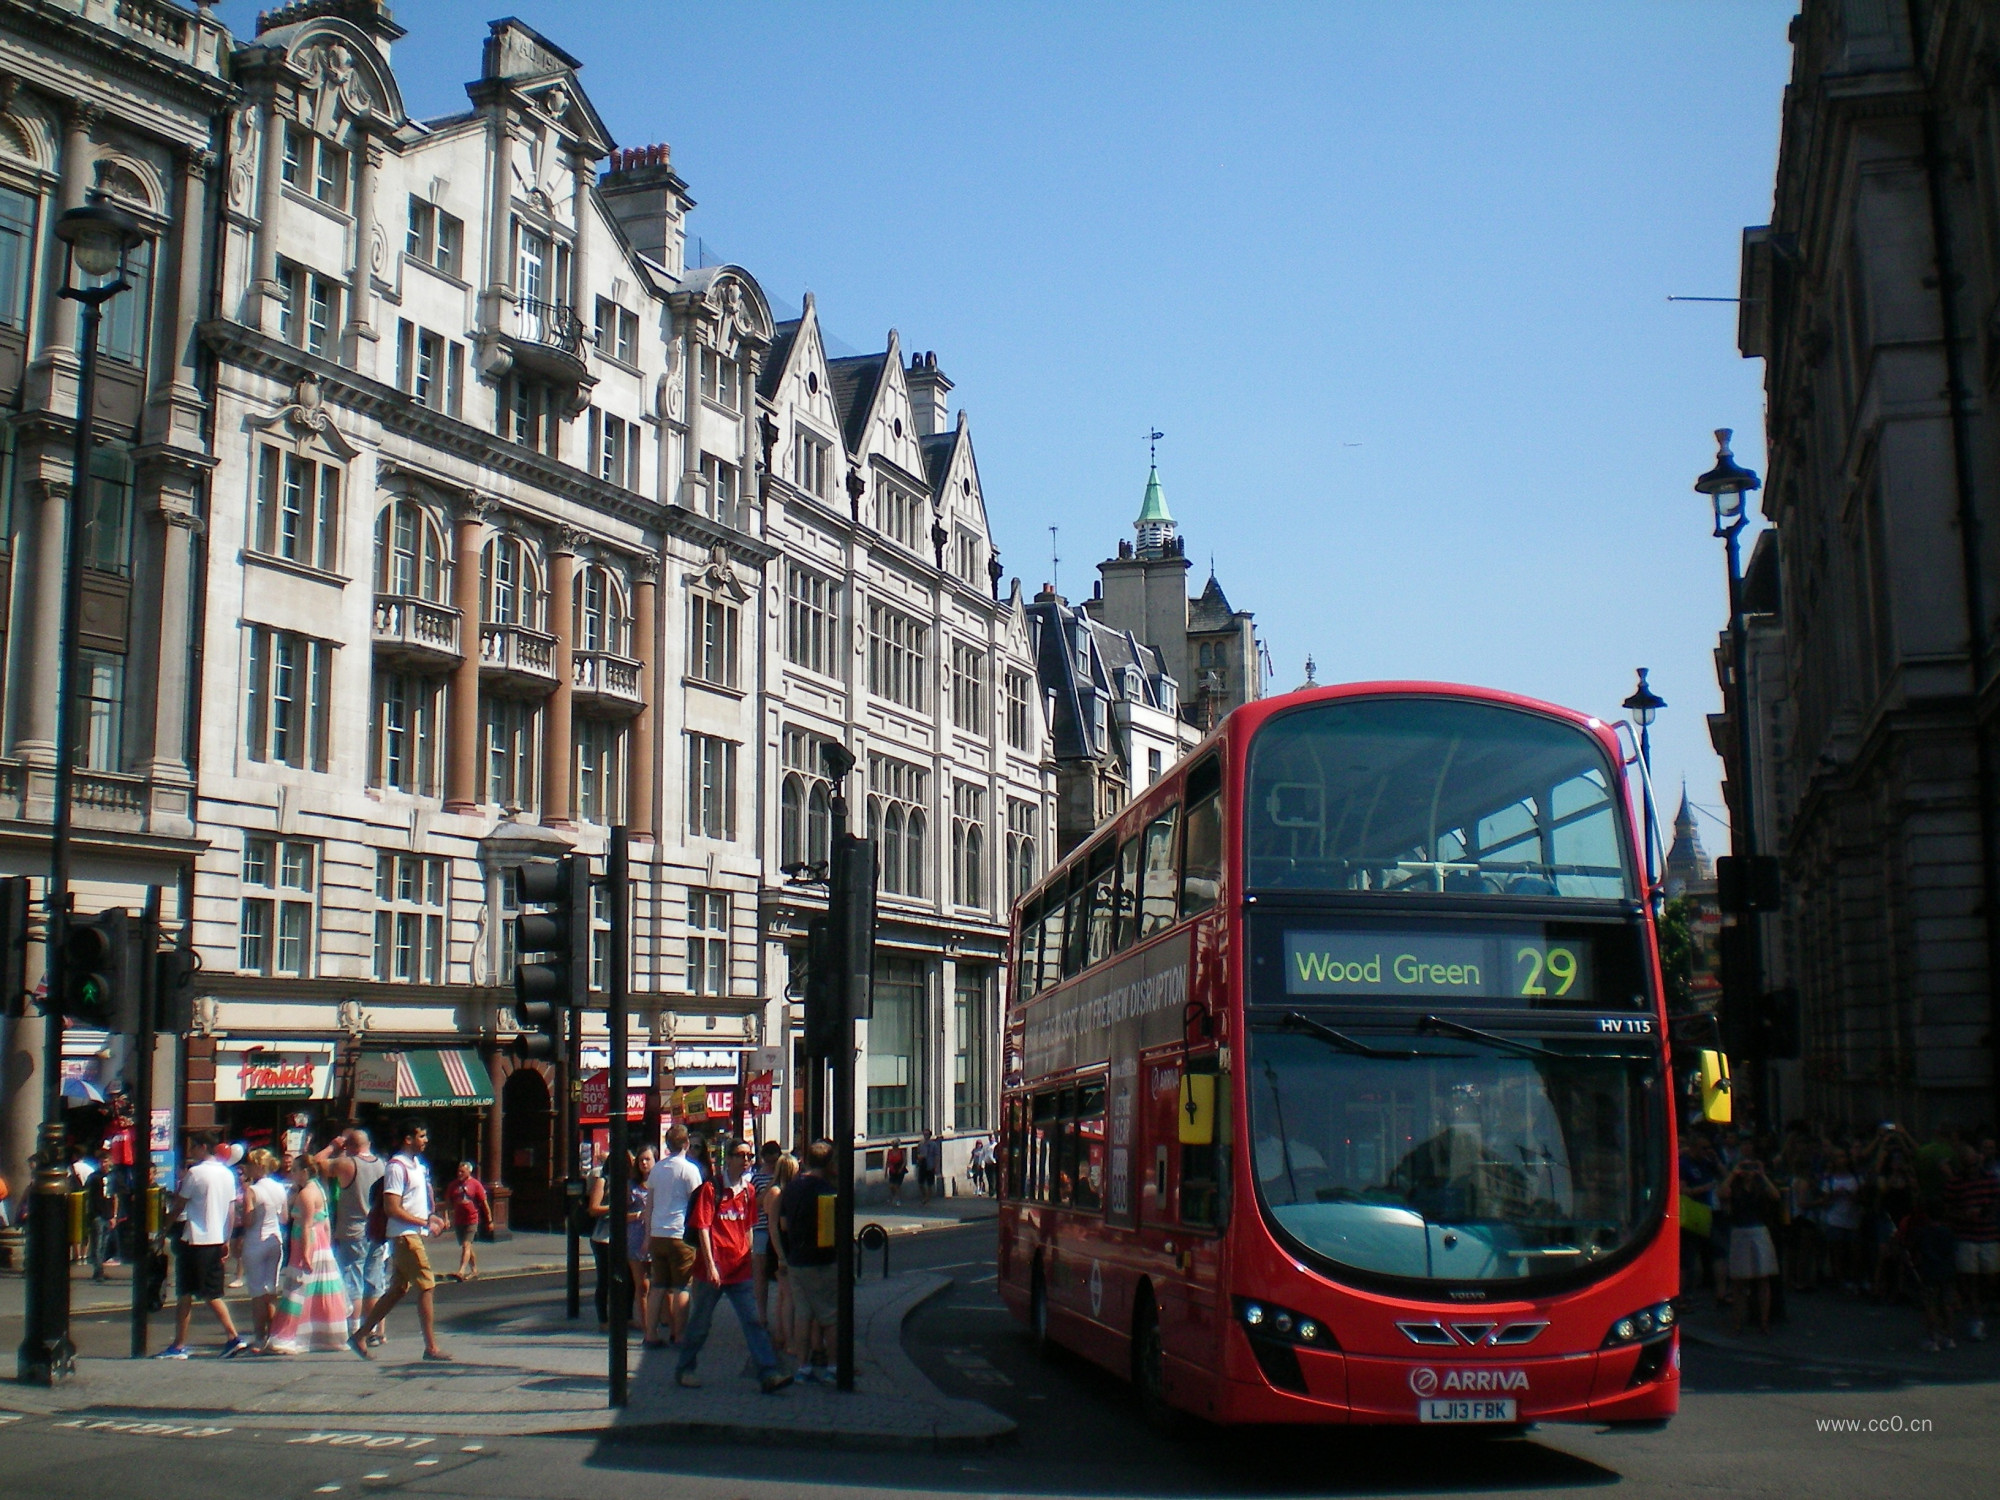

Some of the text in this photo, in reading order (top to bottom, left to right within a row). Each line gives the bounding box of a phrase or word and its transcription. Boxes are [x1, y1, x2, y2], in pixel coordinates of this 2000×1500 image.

[1295, 947, 1578, 996] Wood Green 29
[1130, 963, 1187, 1018] DISRUPTION
[1601, 1019, 1651, 1033] HV 115
[584, 1083, 606, 1092] SALE
[751, 1083, 771, 1092] SALE
[403, 1099, 429, 1108] BURGERS
[432, 1099, 448, 1107] PIZZA
[451, 1098, 470, 1107] GRILLS
[472, 1097, 493, 1106] SALADS
[583, 1092, 608, 1104] 50%
[706, 1092, 732, 1112] ALE
[586, 1104, 604, 1114] OFF
[1443, 1371, 1530, 1391] ARRIVA
[1431, 1402, 1507, 1420] LJ13 FBK
[52, 1419, 437, 1449] LOOK RIGHT
